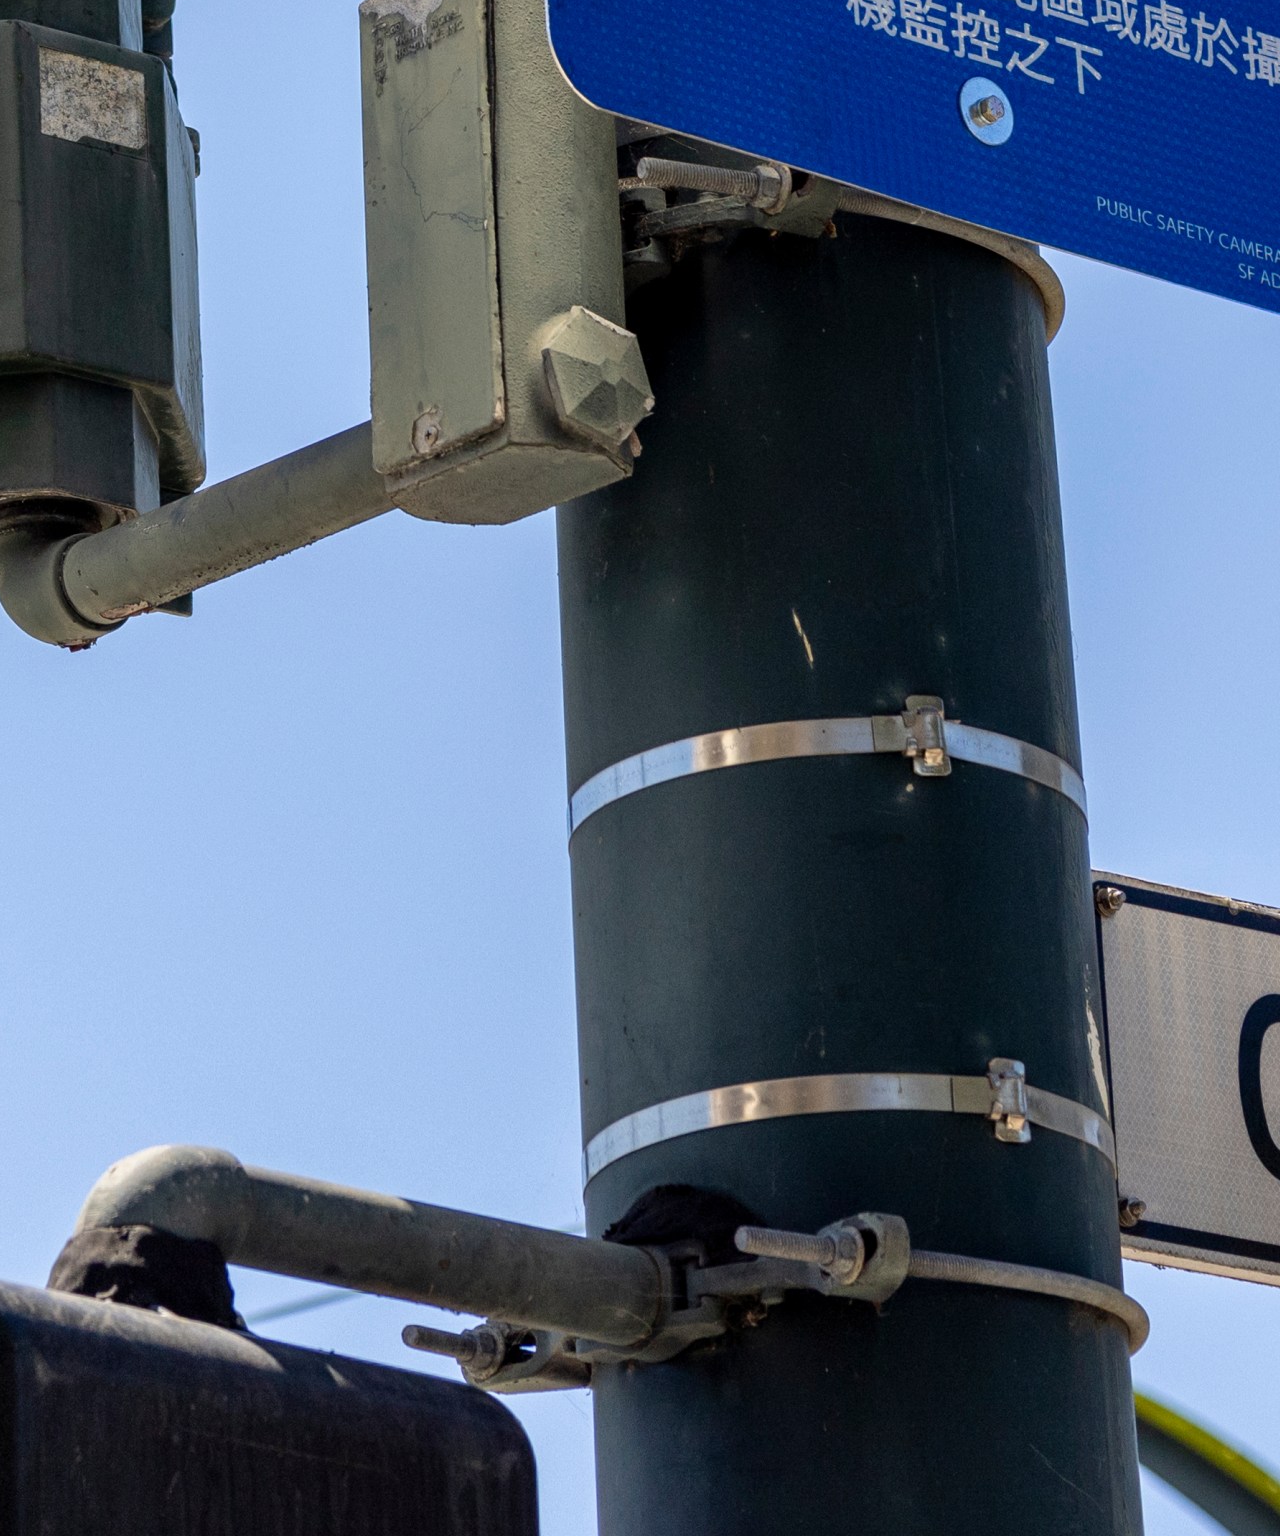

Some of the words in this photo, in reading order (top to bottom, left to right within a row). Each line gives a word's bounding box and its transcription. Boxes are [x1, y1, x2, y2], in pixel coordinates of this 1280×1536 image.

[1096, 196, 1152, 227] PUBLIC
[1157, 214, 1214, 244] SAFETY
[1238, 263, 1256, 280] SF
